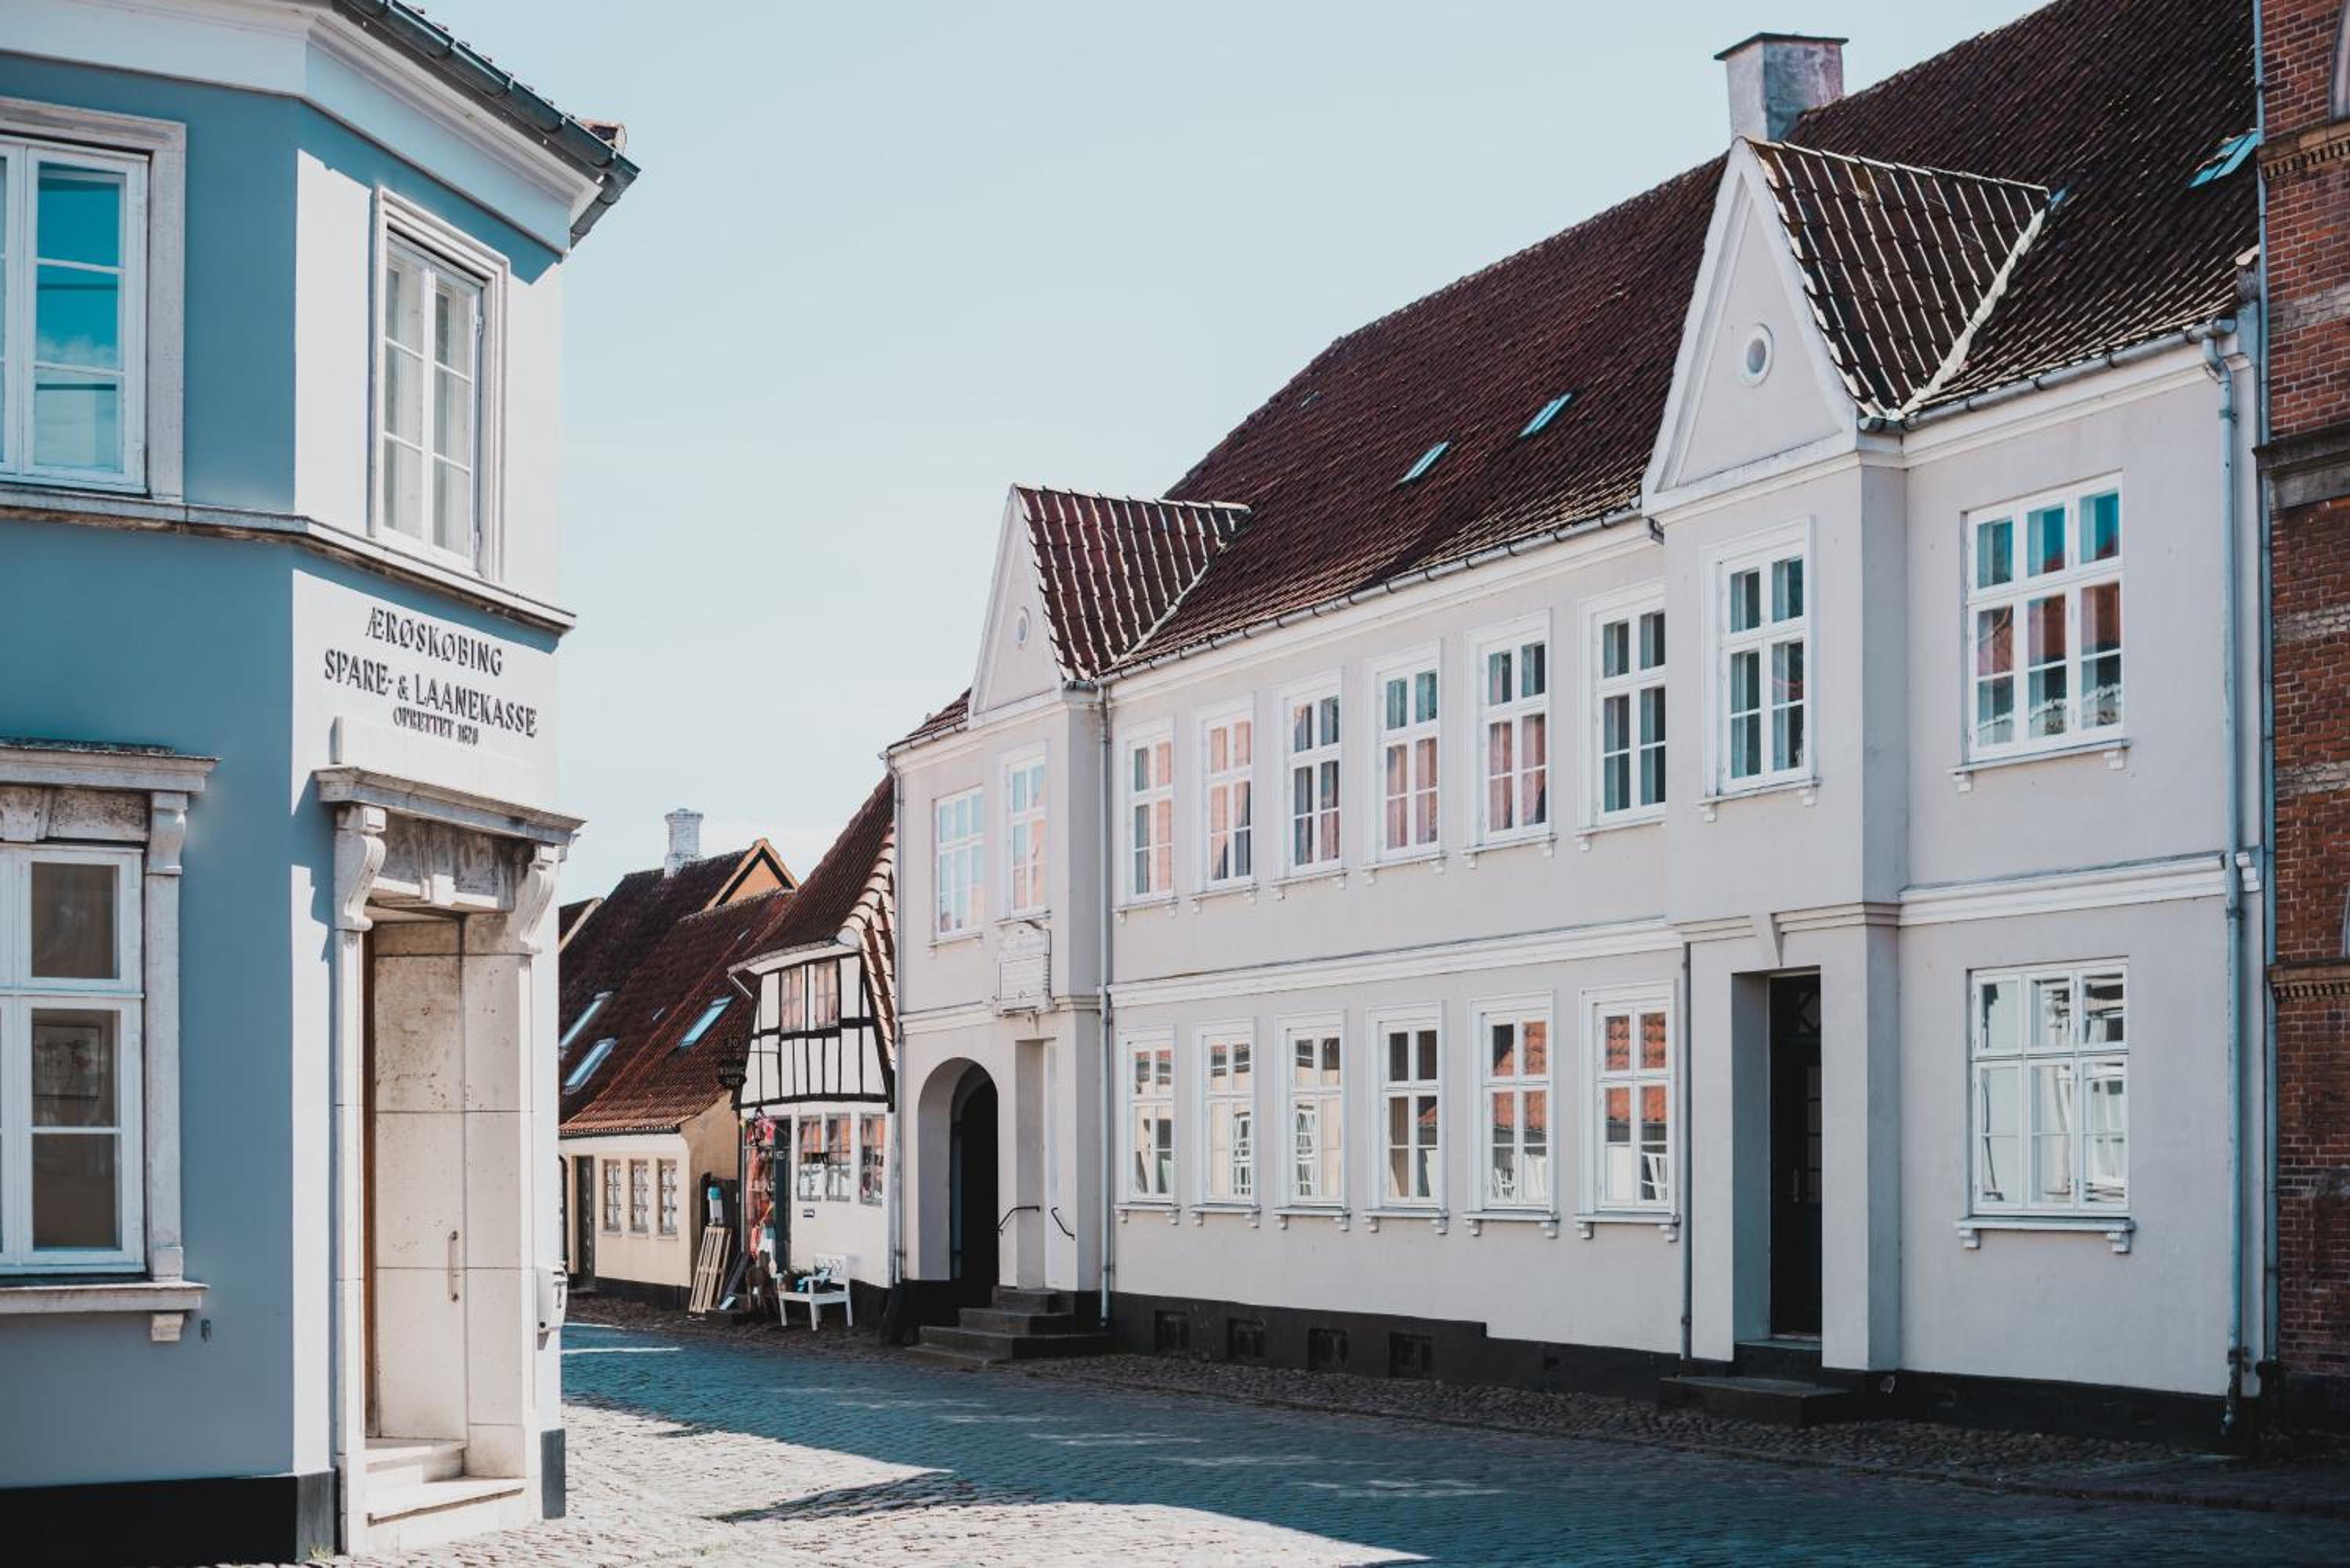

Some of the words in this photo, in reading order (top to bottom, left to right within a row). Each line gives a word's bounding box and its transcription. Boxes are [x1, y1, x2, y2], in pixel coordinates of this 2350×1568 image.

[366, 608, 502, 677] ÆRØSKØBING
[325, 649, 393, 695] SPARE-
[397, 674, 409, 701] &
[415, 674, 539, 739] LAANEKASSE
